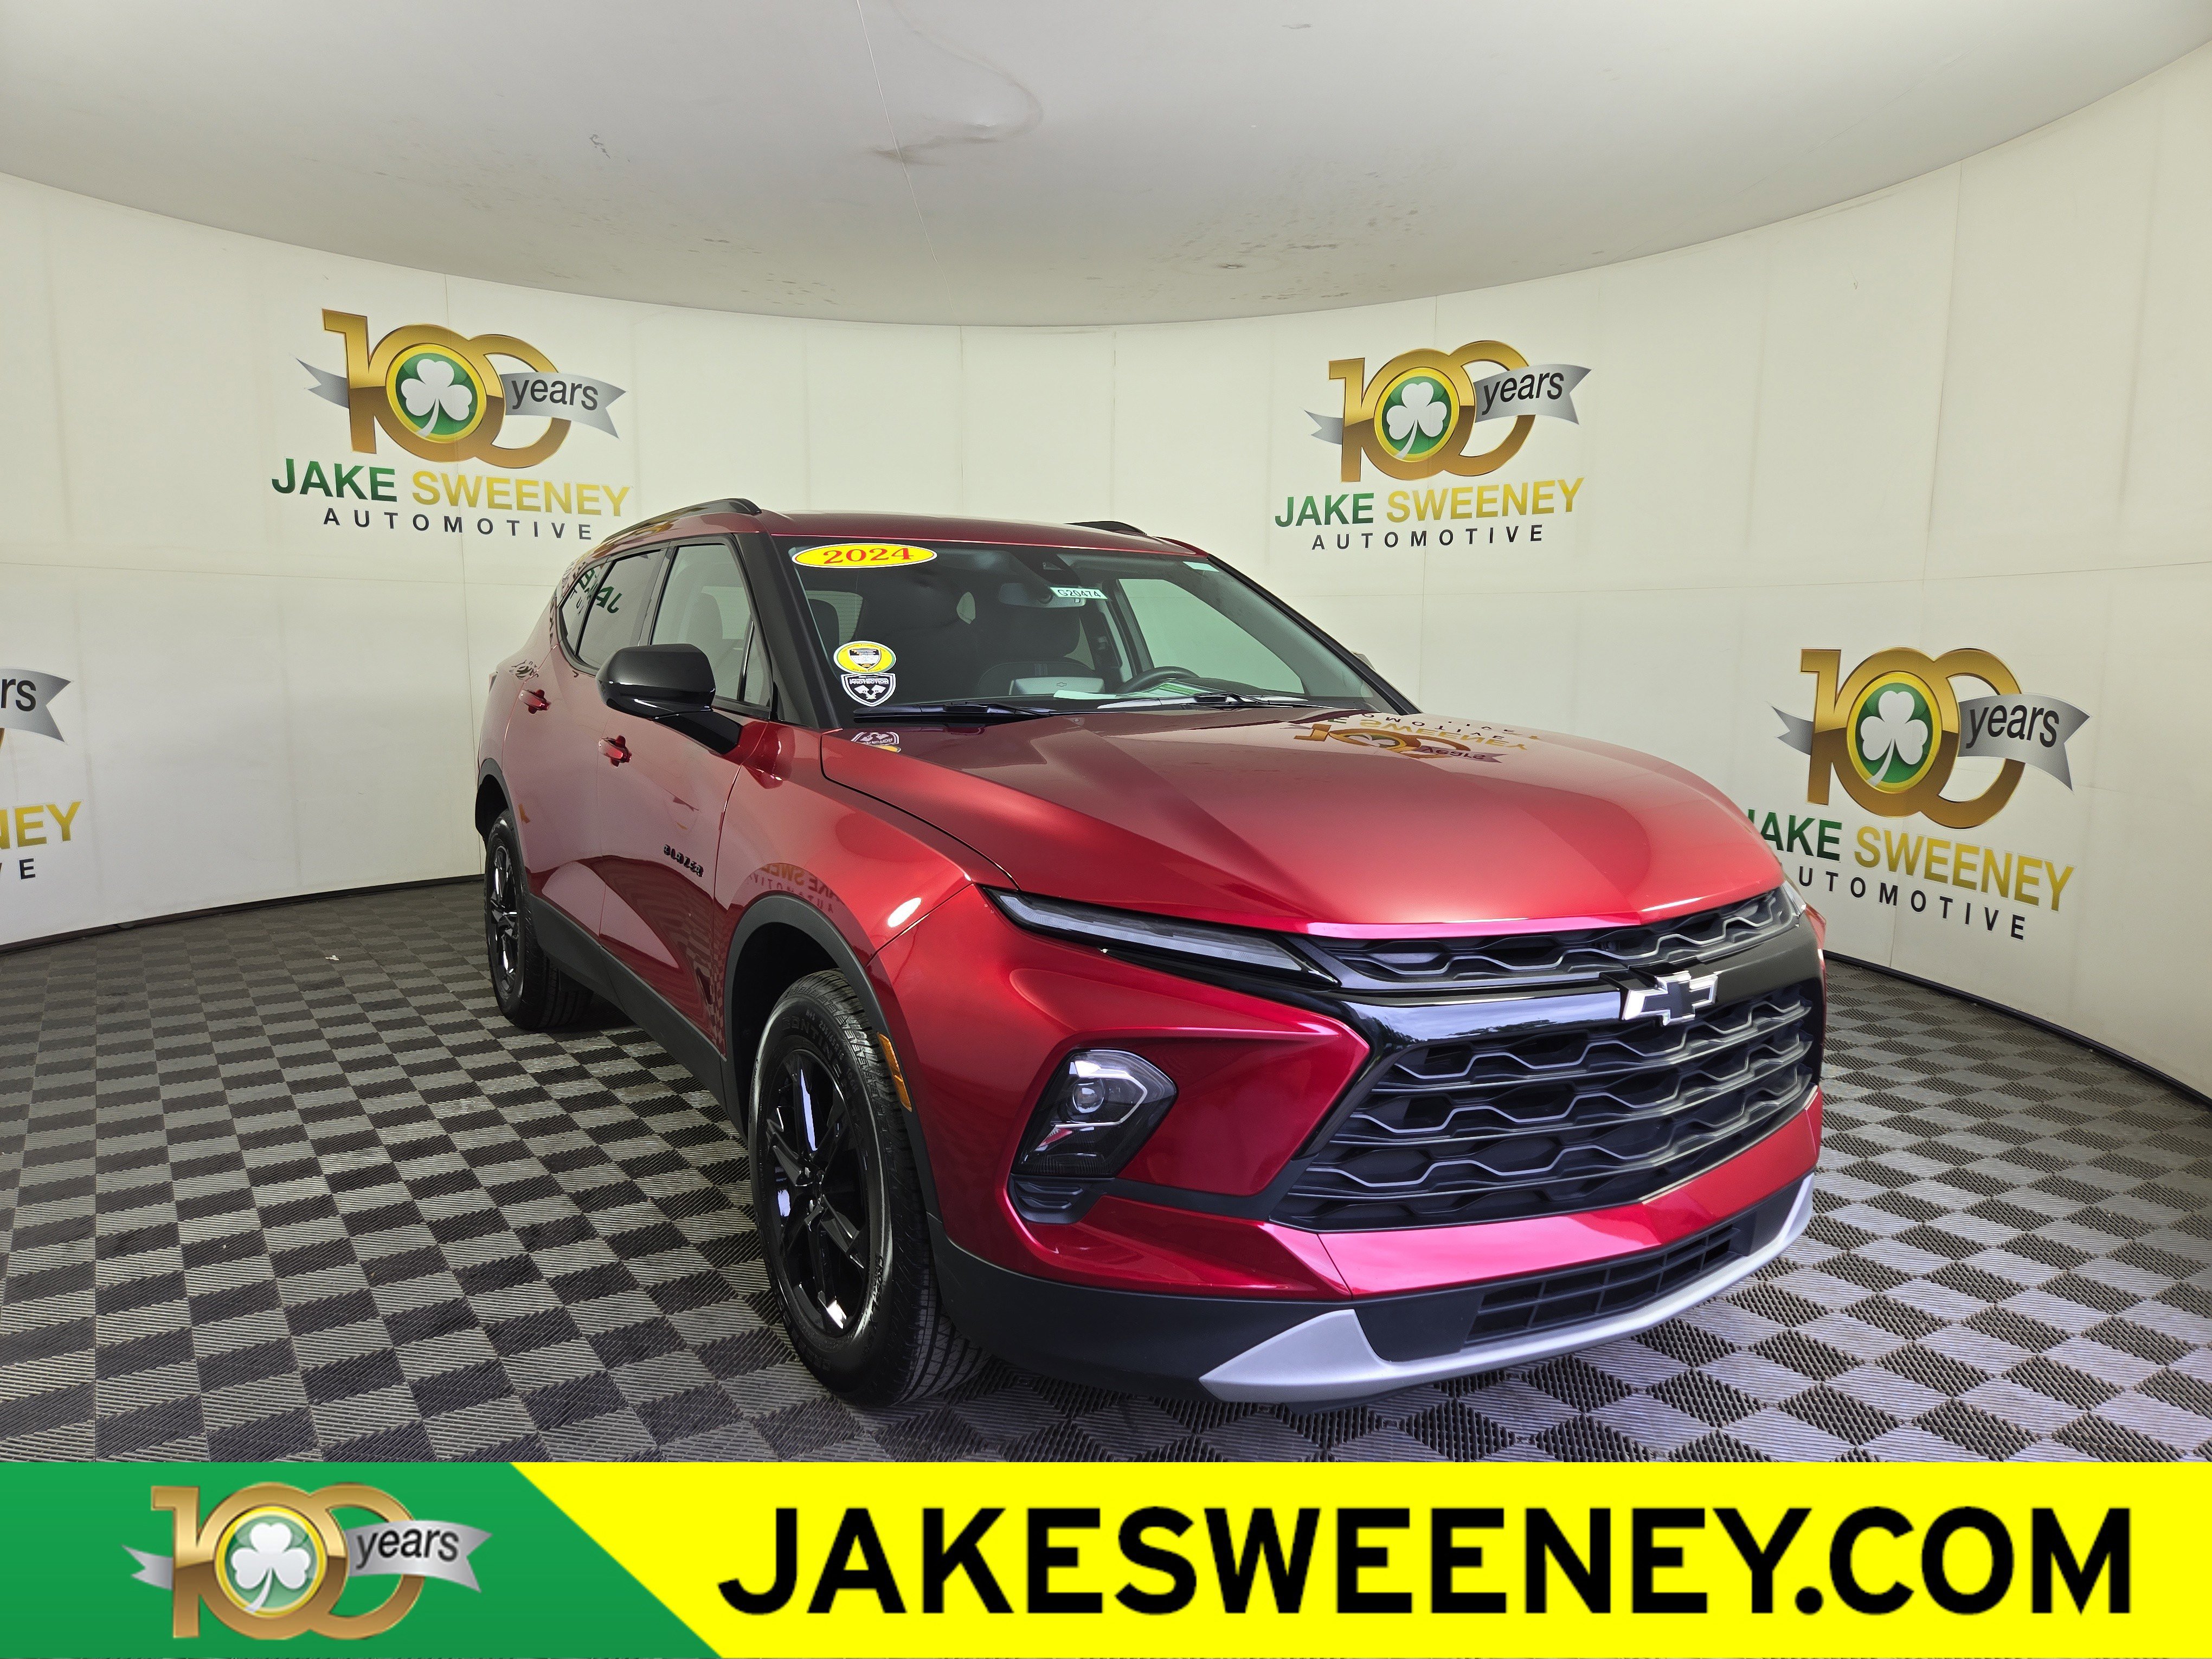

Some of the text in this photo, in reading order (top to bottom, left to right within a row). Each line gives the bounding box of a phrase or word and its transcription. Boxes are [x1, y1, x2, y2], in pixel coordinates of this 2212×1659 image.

[321, 308, 572, 468] 100
[511, 379, 599, 410] years
[1329, 340, 1536, 483] 100
[1482, 371, 1564, 415] years
[272, 458, 631, 517] JAKE SWEENEY
[1275, 478, 1585, 528] JAKE SWEENEY
[323, 507, 591, 540] AUTOMOTIVE
[1311, 525, 1543, 550] AUTOMOTIVE
[823, 548, 914, 564] 2024
[1058, 589, 1101, 598] G20474
[1801, 647, 2025, 829] 100
[1966, 704, 2059, 749] years
[1854, 826, 2074, 911] SWEENEY
[1799, 866, 2025, 940] UTOMOTIVE
